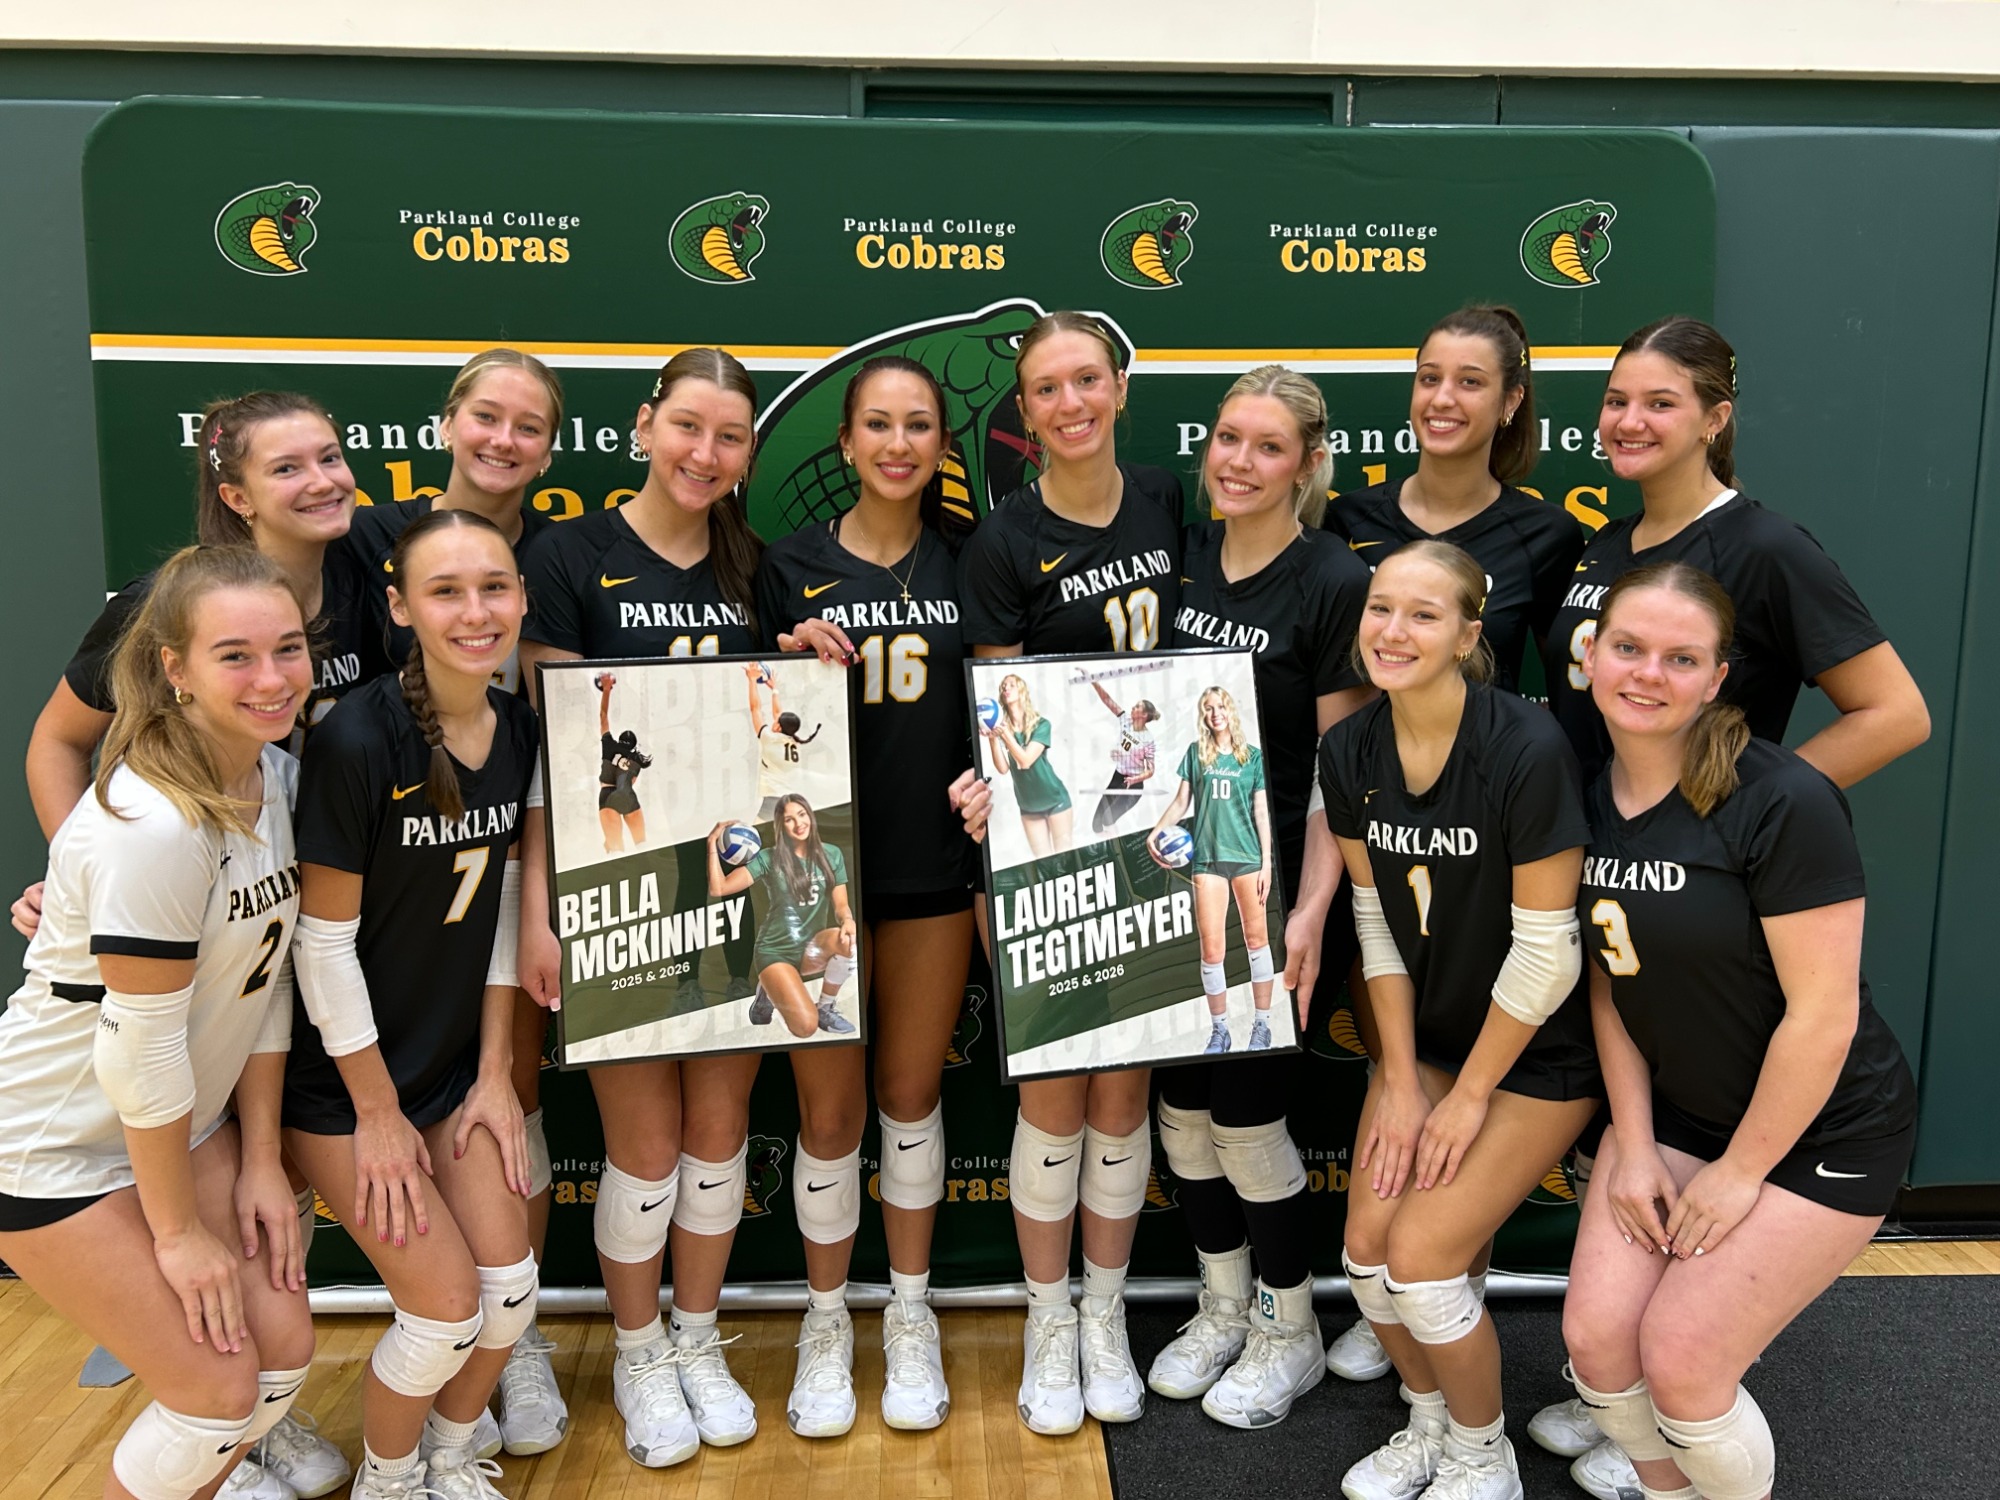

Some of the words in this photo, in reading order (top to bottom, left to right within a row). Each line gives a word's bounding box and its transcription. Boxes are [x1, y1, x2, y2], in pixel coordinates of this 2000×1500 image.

[399, 210, 494, 226] Parkland
[503, 212, 581, 230] College
[843, 218, 934, 233] Parkland
[942, 219, 1016, 237] College
[1269, 223, 1358, 238] Parkland
[1366, 223, 1438, 240] College
[413, 226, 570, 263] Cobras
[856, 234, 1005, 270] Cobras
[1281, 238, 1427, 273] Cobras
[1176, 421, 1419, 455] Pand
[1060, 549, 1171, 603] PARKLAND
[619, 601, 749, 628] PARKLAN
[822, 600, 959, 629] PARKLAND
[1103, 587, 1159, 653] 10
[860, 633, 929, 704] 16
[784, 742, 799, 763] 16
[1212, 777, 1231, 800] 10
[401, 801, 518, 847] PARKLAND
[1367, 820, 1479, 856] ARKLAND
[443, 846, 490, 925] 7
[1582, 855, 1687, 892] RKLAND
[227, 863, 300, 923] PARKLAN
[558, 871, 661, 939] BELLA
[994, 861, 1117, 941] LAUREN
[1407, 865, 1432, 936] 1
[571, 896, 746, 984] MCKINNEY
[1006, 890, 1193, 988] TEGTMEYER
[1590, 898, 1642, 976] 3
[239, 916, 285, 1000] 2
[611, 972, 643, 991] 2025
[646, 970, 657, 982] &
[659, 961, 691, 979] 2026
[1048, 976, 1079, 997] 2025
[1082, 974, 1092, 987] &
[1094, 963, 1125, 983] 2026
[951, 1156, 1010, 1171] Colleg
[1297, 1147, 1347, 1160] kland
